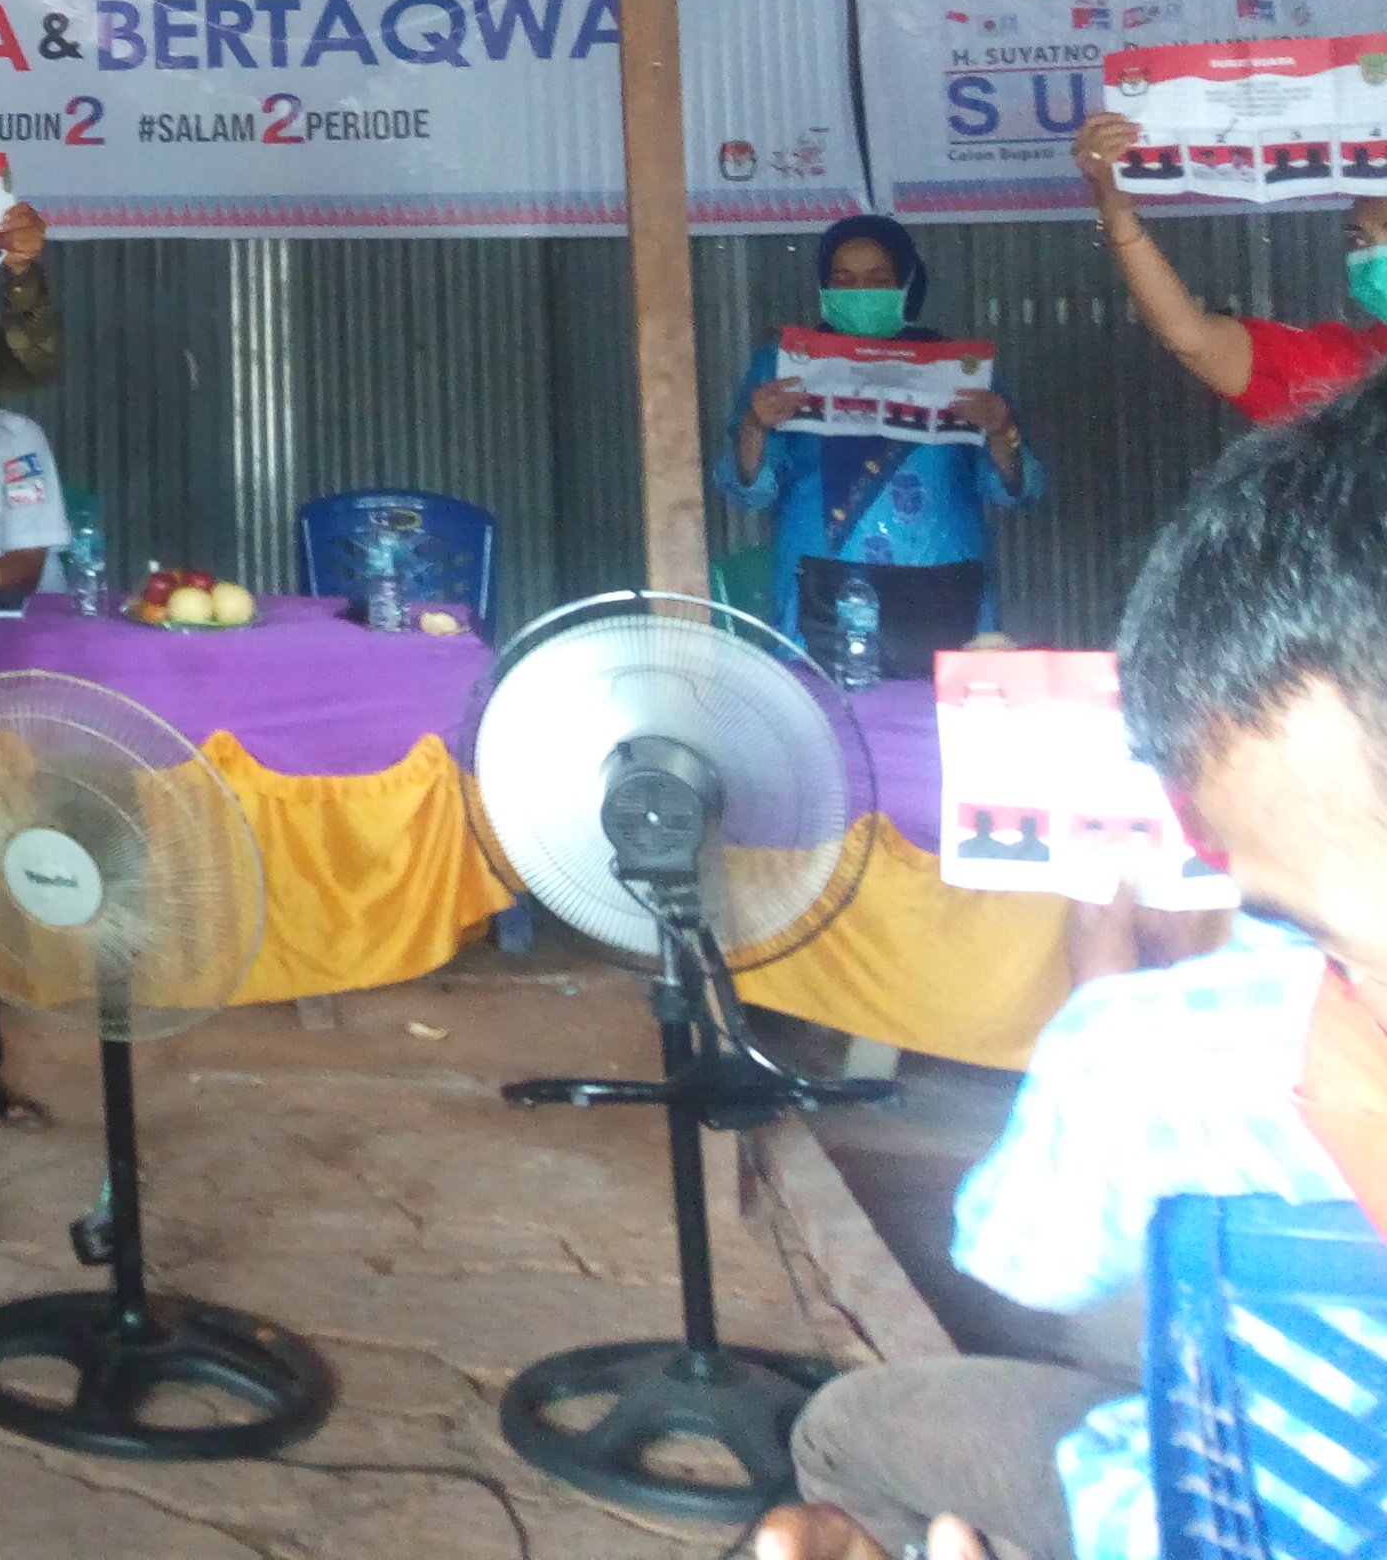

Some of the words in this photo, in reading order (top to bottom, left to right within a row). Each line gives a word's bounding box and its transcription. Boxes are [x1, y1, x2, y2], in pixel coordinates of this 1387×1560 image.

[38, 11, 84, 59] &
[985, 43, 1100, 65] SUYATNO
[139, 92, 430, 144] #SALAM2PERIODE
